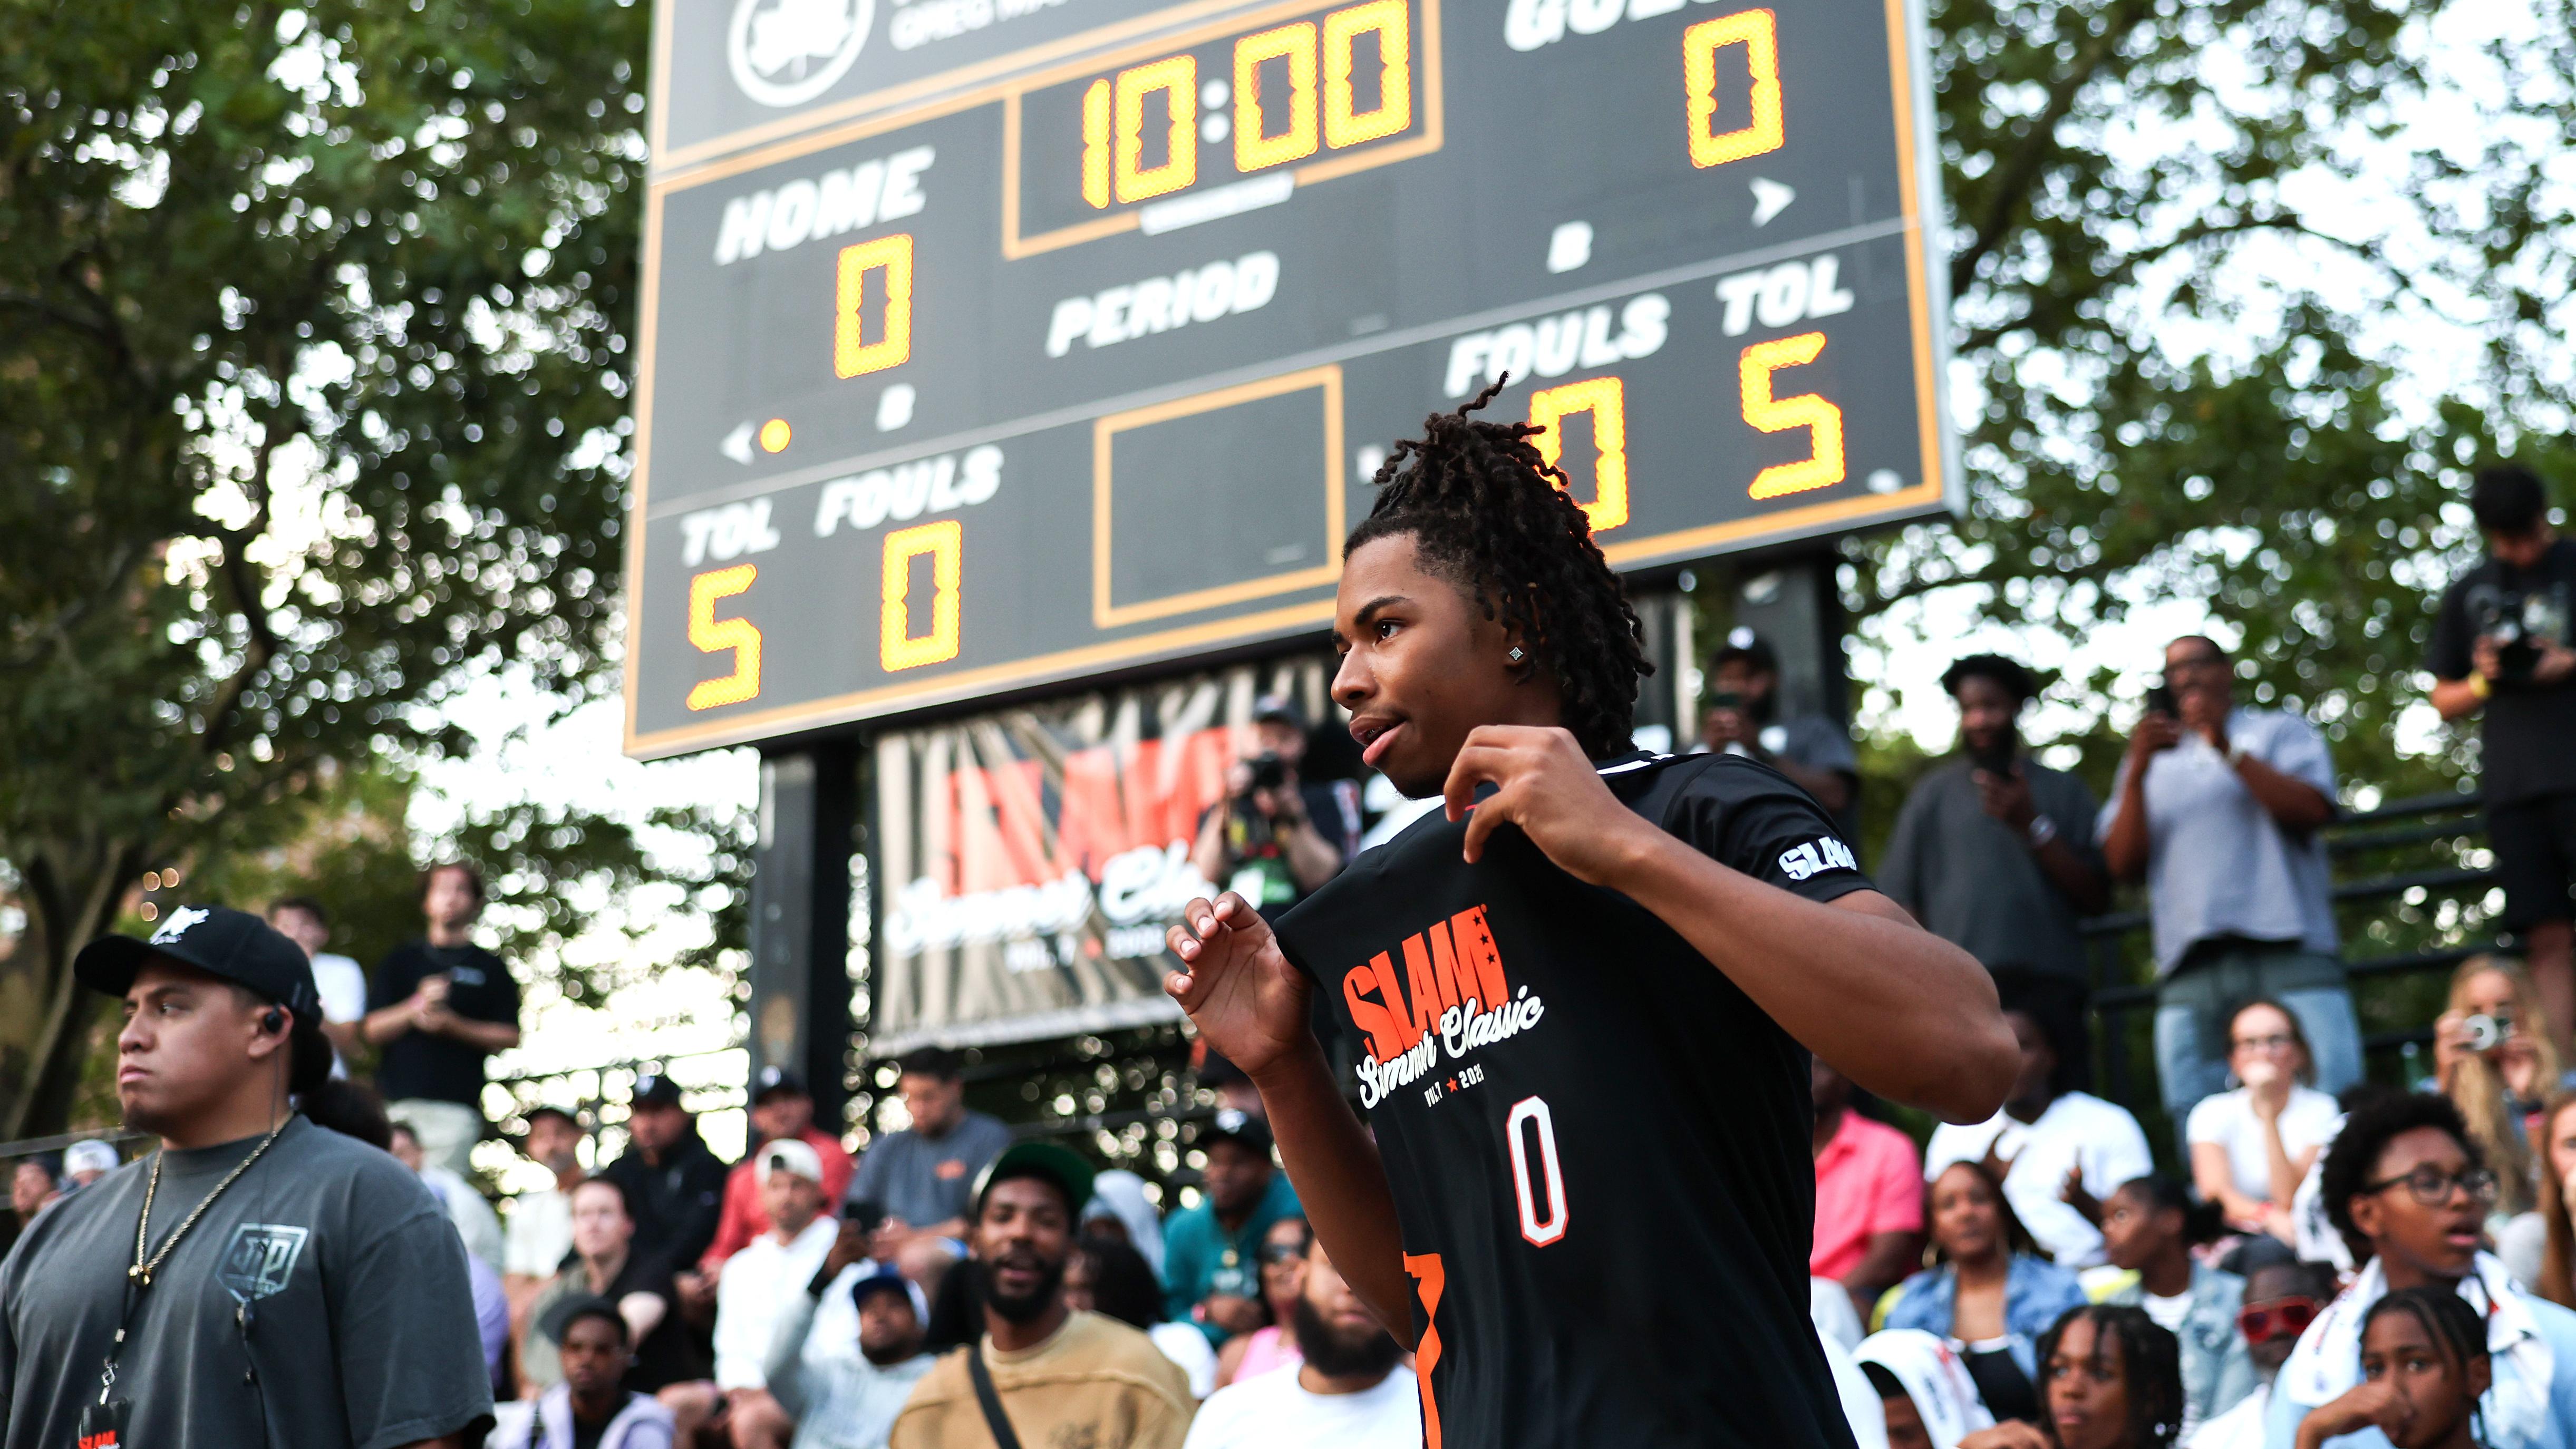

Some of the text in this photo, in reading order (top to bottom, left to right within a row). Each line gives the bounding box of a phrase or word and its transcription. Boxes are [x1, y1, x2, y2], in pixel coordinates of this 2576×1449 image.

[1081, 0, 1412, 209] 10:00
[1682, 7, 1785, 170] 0
[713, 144, 936, 266] HOME
[834, 234, 914, 379] 0
[1045, 250, 1280, 358] PERIOD
[1444, 293, 1670, 399] FOULS
[1715, 254, 1855, 337] TOL
[1531, 376, 1630, 533] 0
[1739, 330, 1846, 501] 5
[680, 495, 781, 568] TOL
[813, 444, 1005, 538] FOULS
[686, 562, 763, 712] 5
[879, 519, 963, 674] 0
[1343, 906, 1509, 1067] SLAM
[1439, 985, 1545, 1058] Classic
[1506, 1095, 1570, 1249] 0
